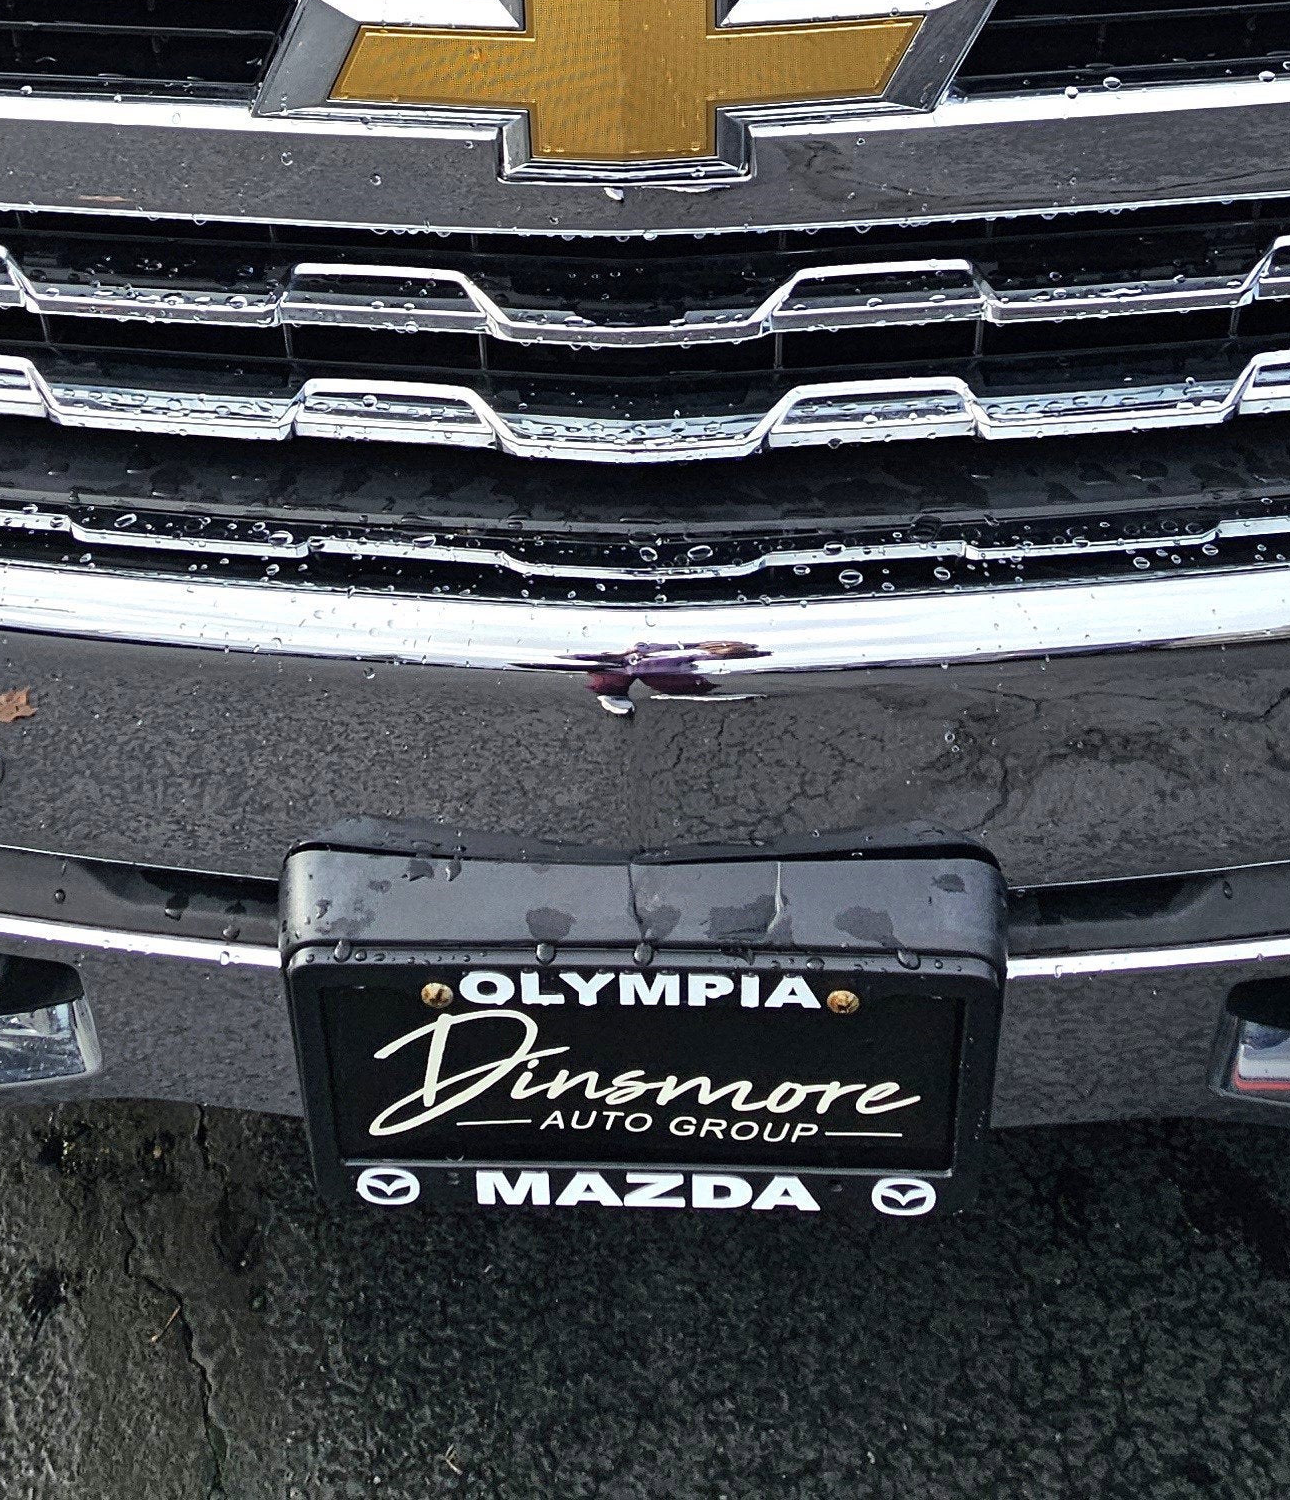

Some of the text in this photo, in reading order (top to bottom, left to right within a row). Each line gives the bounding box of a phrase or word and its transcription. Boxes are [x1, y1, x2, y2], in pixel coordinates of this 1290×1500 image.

[458, 970, 822, 1009] OLYMPIA
[368, 1009, 921, 1137] Dinsmore
[539, 1110, 819, 1143] AUTO GROUP
[475, 1170, 821, 1212] MAZDA
